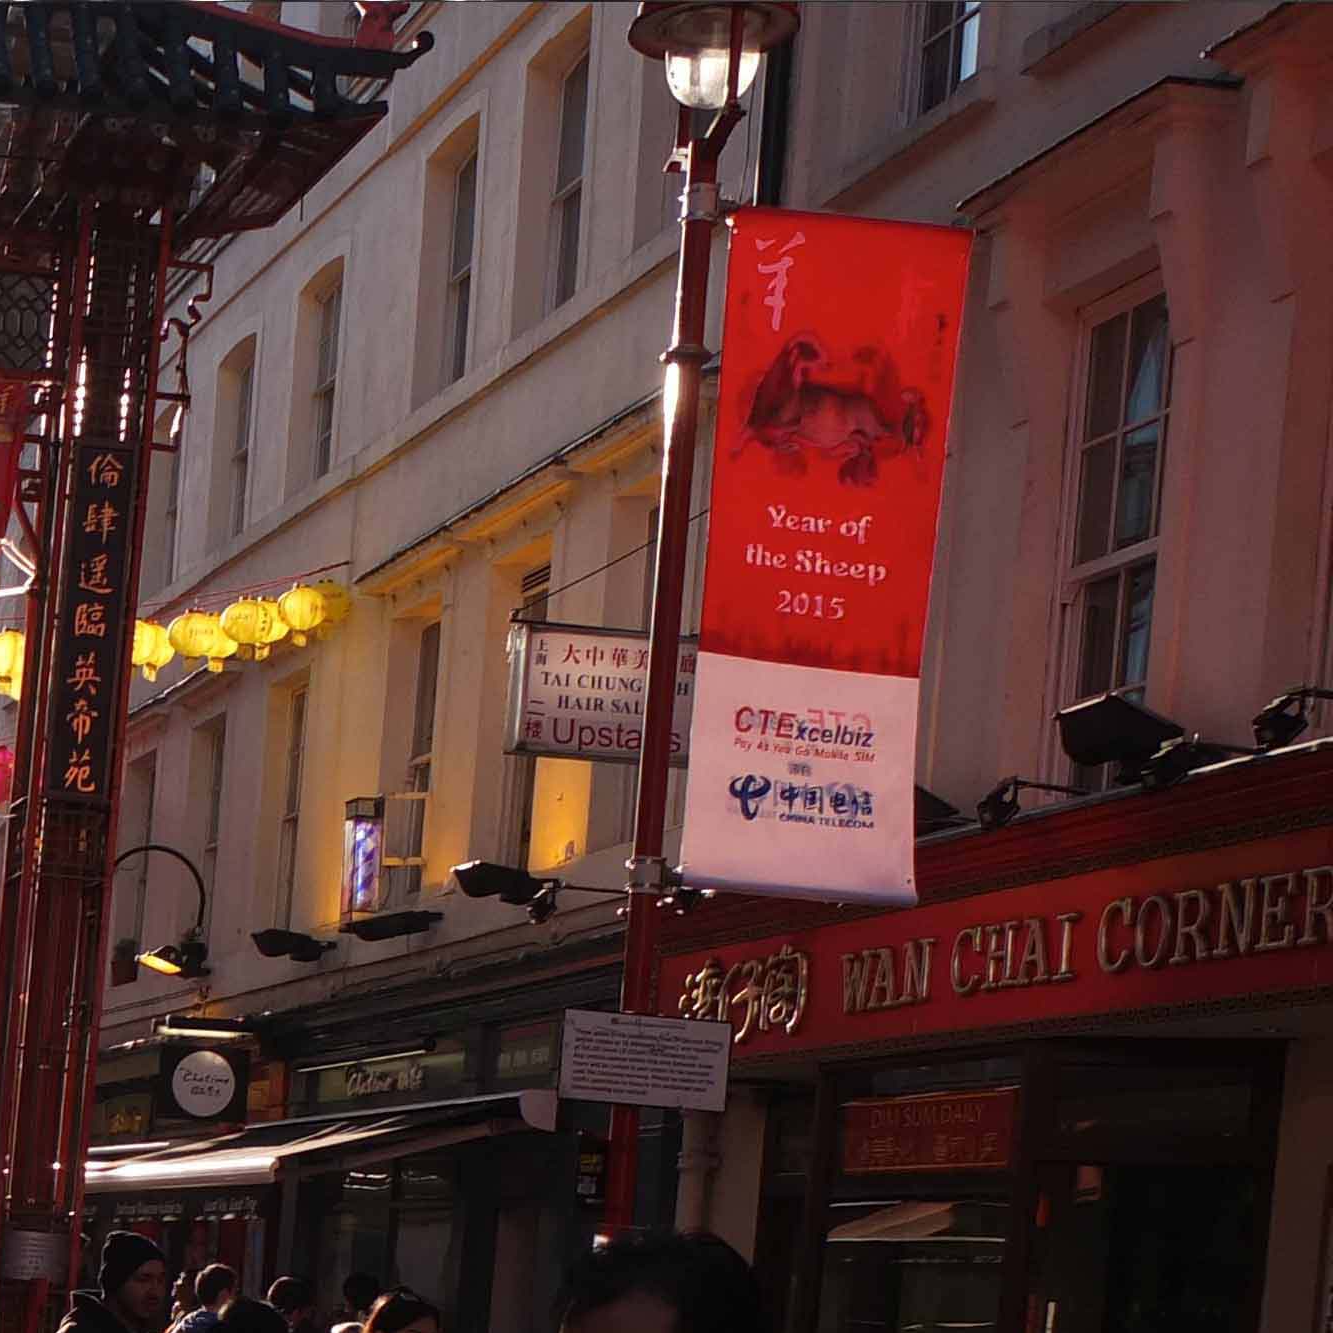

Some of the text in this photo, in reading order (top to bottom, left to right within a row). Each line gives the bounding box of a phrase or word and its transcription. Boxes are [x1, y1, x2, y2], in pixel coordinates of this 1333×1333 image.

[765, 502, 873, 545] Year of
[744, 543, 887, 588] the Sheep
[774, 589, 846, 620] 2015
[540, 671, 643, 695] TAI CHUNG
[556, 694, 644, 716] HAIR SAL
[552, 717, 682, 754] Upstas
[734, 738, 752, 752] Pay
[853, 751, 876, 763] SIM
[778, 812, 875, 830] CHINA TELECOM
[837, 864, 1333, 1017] WAN CHAI CORNER
